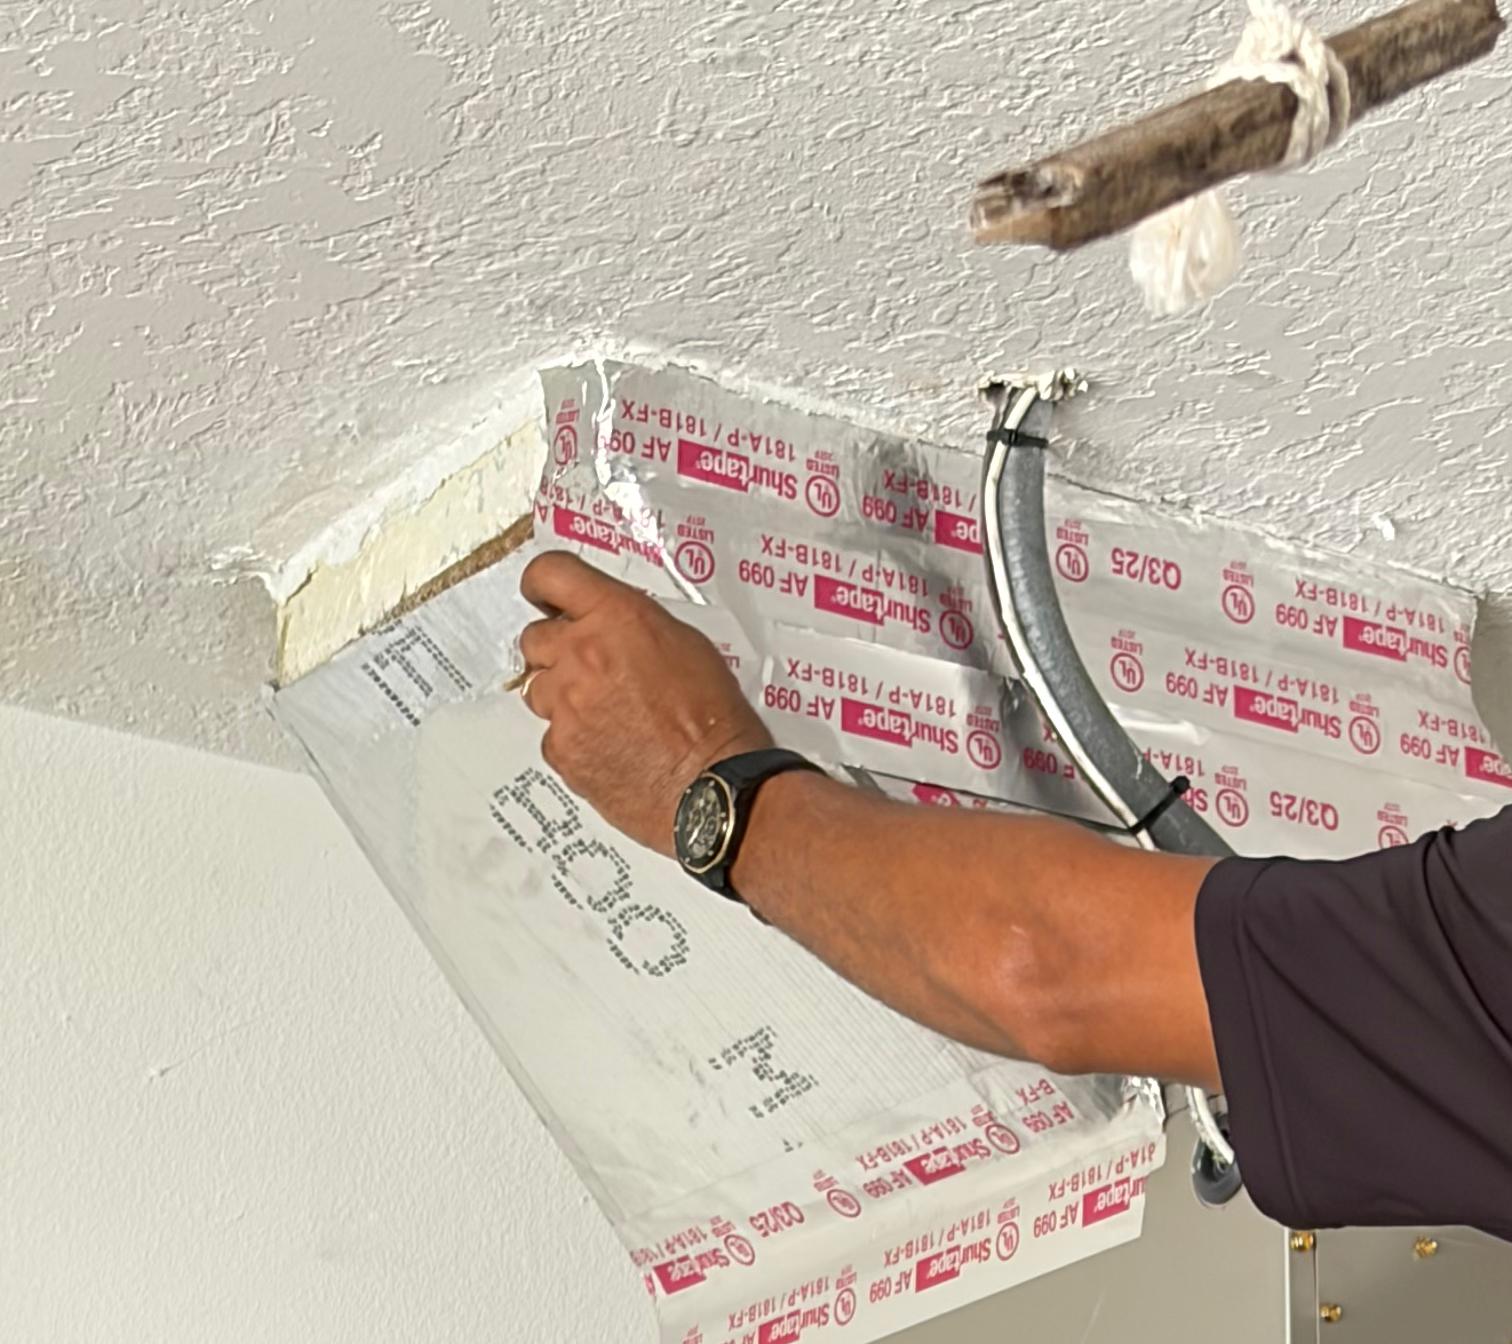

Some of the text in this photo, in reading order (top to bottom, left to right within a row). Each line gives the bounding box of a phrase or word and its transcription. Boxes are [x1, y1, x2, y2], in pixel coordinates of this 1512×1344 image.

[621, 399, 707, 437] 181B-FX
[642, 439, 671, 462] AF
[727, 429, 795, 462] 181A-P
[863, 493, 896, 524] 099
[902, 507, 929, 533] AF
[761, 535, 841, 572] 181B-FX
[739, 560, 774, 587] 099
[862, 564, 929, 597] 181A-P
[1111, 548, 1181, 590] Q3/25
[780, 572, 809, 597] AF
[1296, 580, 1367, 613] 181B-FX
[1276, 604, 1308, 629] 099
[1313, 615, 1337, 637] AF
[1386, 603, 1444, 633] 181A-P
[787, 659, 868, 696] 181B-FX
[1185, 648, 1258, 684] 181B-FX
[764, 684, 801, 712] 099
[1166, 672, 1197, 698] 099
[1203, 683, 1228, 706] AF
[1278, 674, 1339, 703] 181A-P
[807, 695, 835, 720] AF
[889, 686, 957, 717] 181A-P
[1401, 733, 1459, 767] AF 099
[1270, 791, 1338, 830] Q3/25
[1048, 1165, 1101, 1201] 181B-FX
[1033, 1201, 1078, 1238] AF 099
[869, 1278, 892, 1303] 099
[895, 1269, 912, 1295] AF
